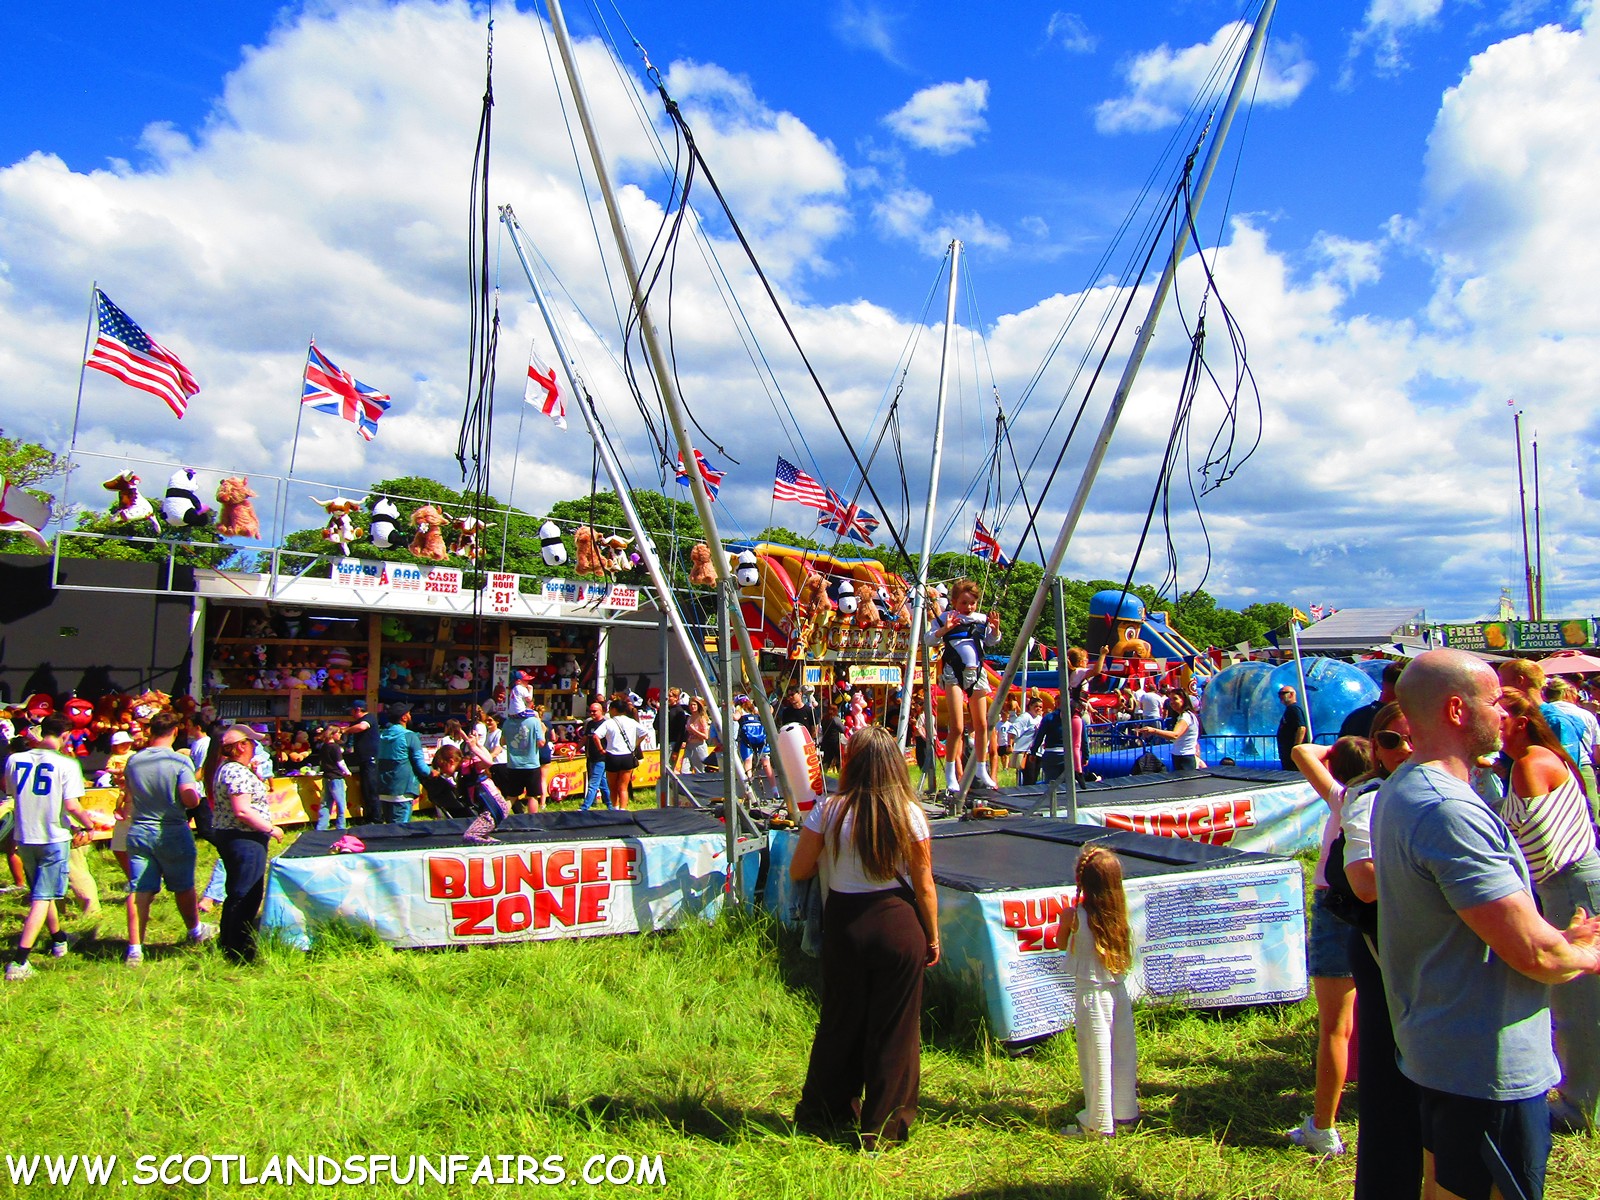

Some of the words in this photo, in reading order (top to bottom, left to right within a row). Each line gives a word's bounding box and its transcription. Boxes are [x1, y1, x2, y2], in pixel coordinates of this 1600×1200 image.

[428, 571, 458, 582] CASH
[493, 573, 515, 582] HAPPY
[425, 582, 458, 594] PRIZE
[492, 581, 514, 589] HOUR
[495, 591, 510, 604] £1
[613, 587, 636, 598] CASH
[610, 596, 636, 607] PRIZE
[1448, 626, 1483, 637] FREE
[1521, 623, 1559, 634] FREE
[827, 627, 883, 649] CHEAP
[1521, 633, 1561, 641] CAPYBARA
[806, 668, 821, 683] WIN
[851, 668, 877, 677] CHOOSE
[879, 669, 900, 682] PRIZE
[16, 762, 54, 795] 76
[552, 776, 567, 788] £1
[429, 847, 637, 899] BUNGEE
[451, 883, 610, 936] ZONE
[1003, 894, 1076, 928] BUN
[1152, 941, 1185, 951] FOLLOWING
[1186, 936, 1227, 947] RESTRICTIONS
[1229, 935, 1245, 943] ALSO
[1246, 933, 1264, 941] APPLY
[1215, 995, 1233, 1004] email
